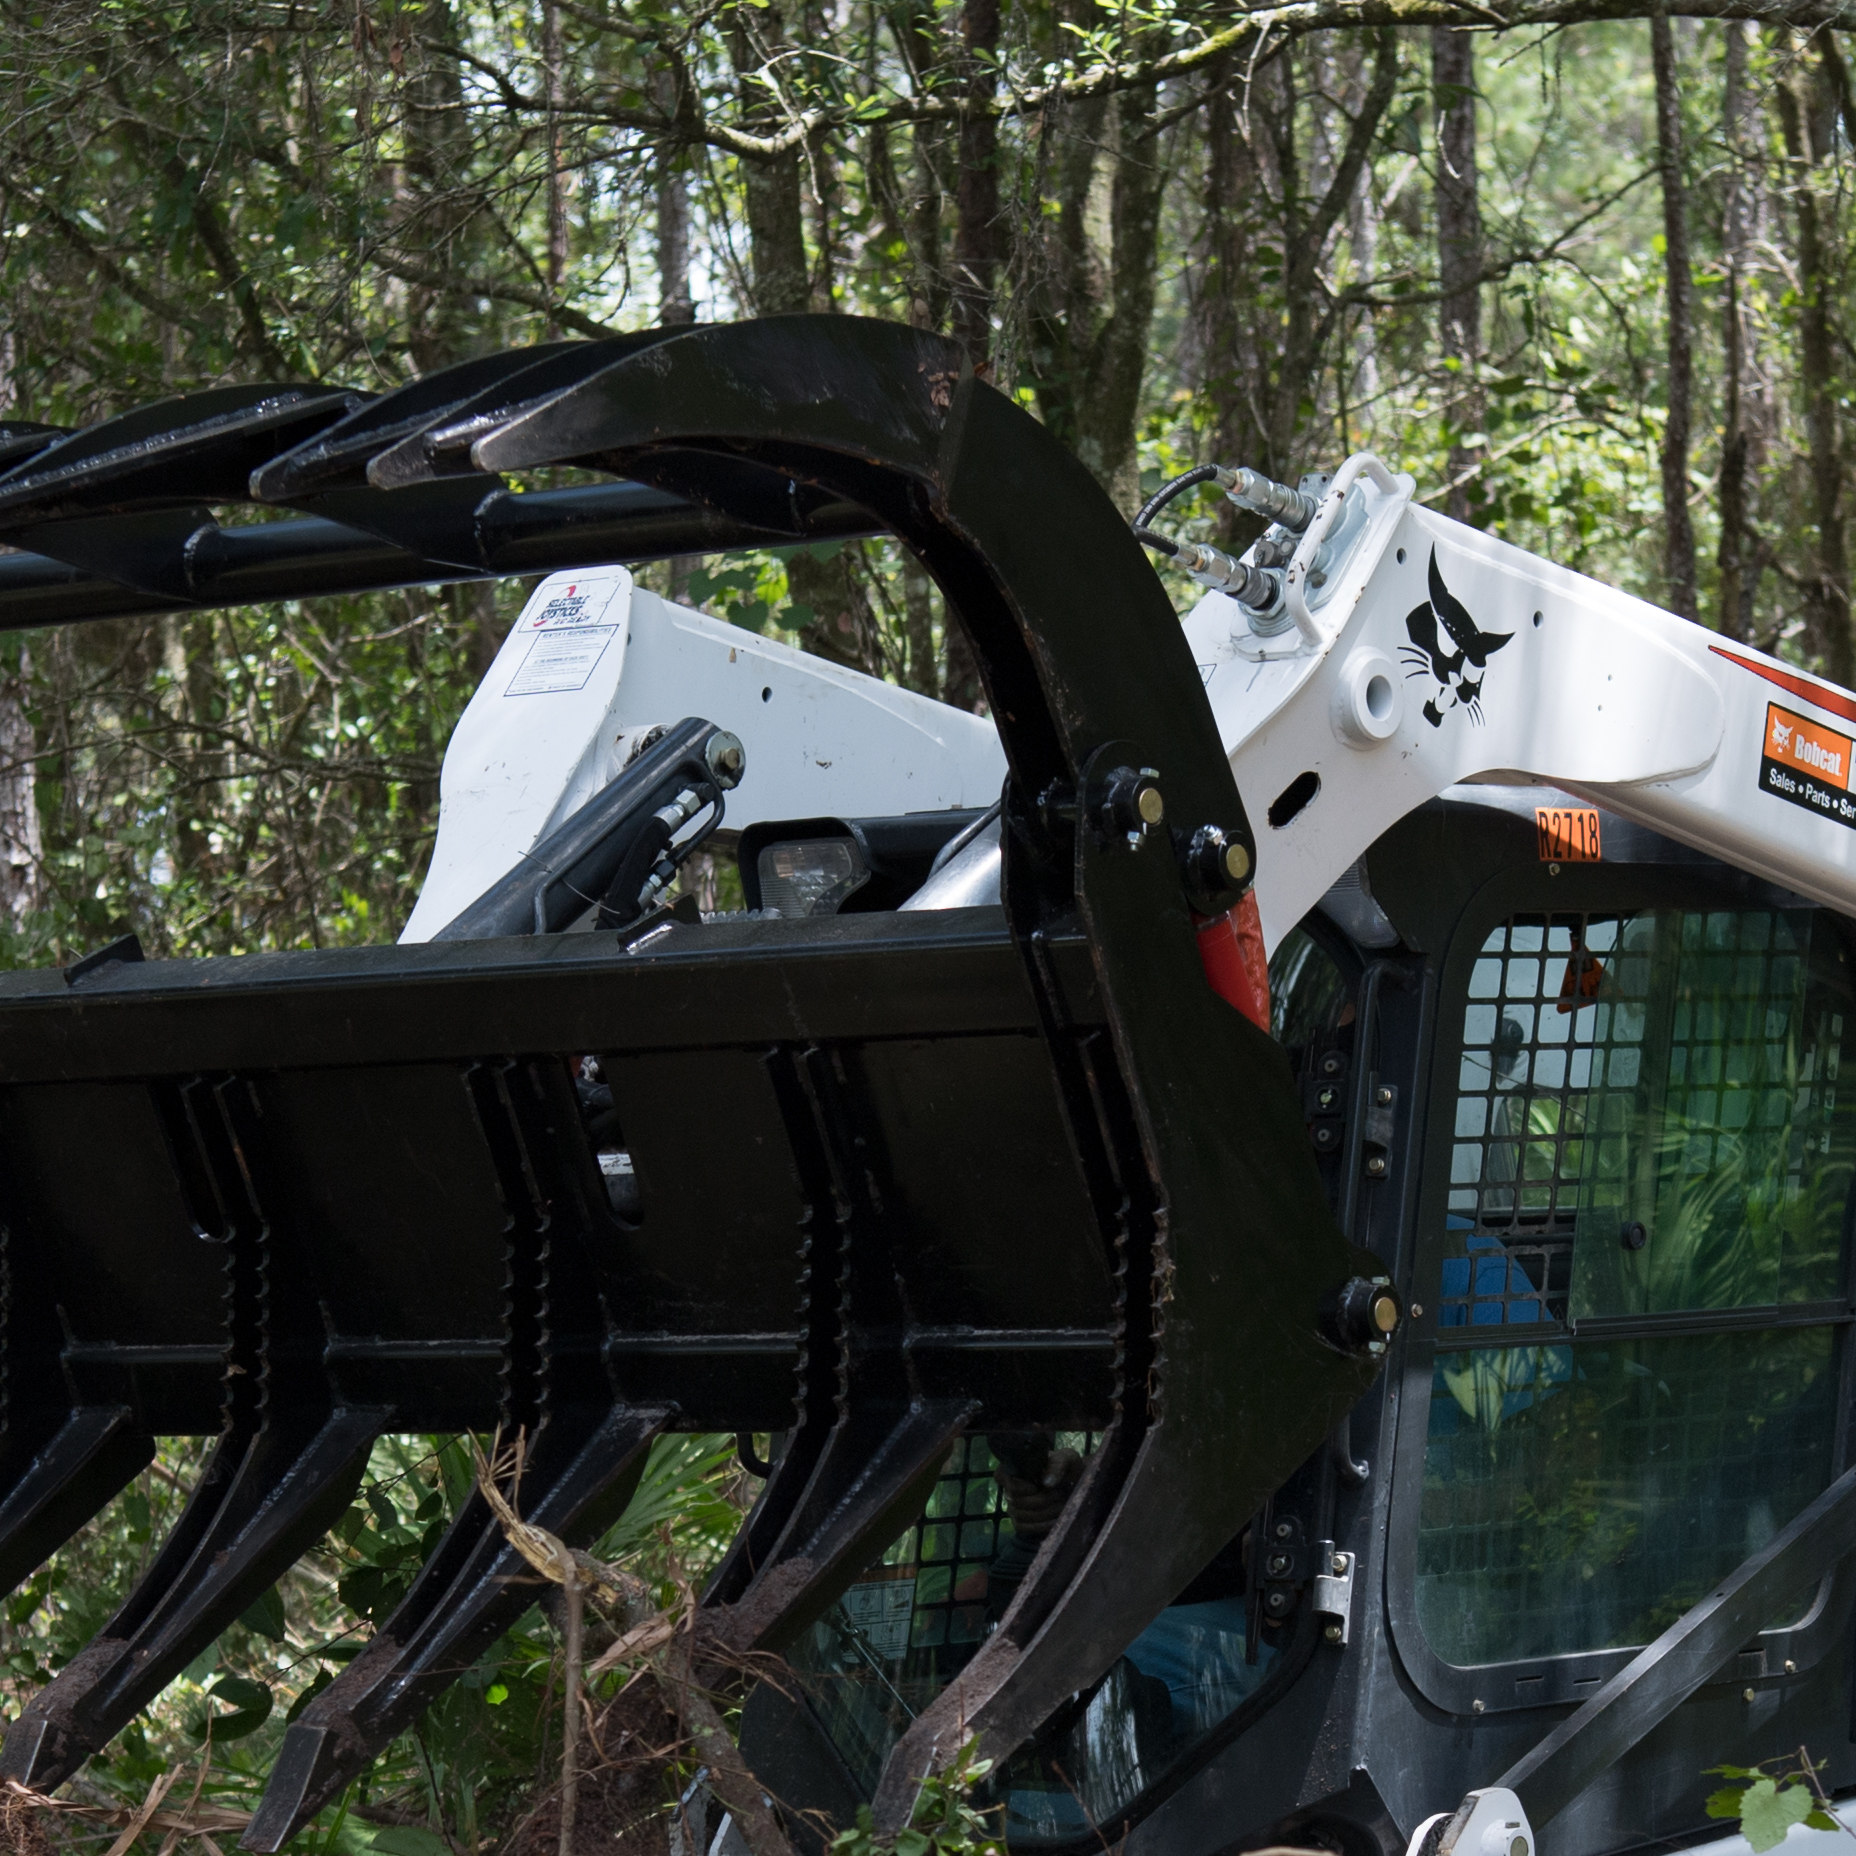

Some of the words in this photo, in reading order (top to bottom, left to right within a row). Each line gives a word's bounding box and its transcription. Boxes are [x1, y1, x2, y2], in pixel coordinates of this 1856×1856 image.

[1794, 733, 1842, 776] Bobcat
[1769, 767, 1796, 793] Sales
[1805, 783, 1830, 808] Parts
[1539, 811, 1599, 859] R2718
